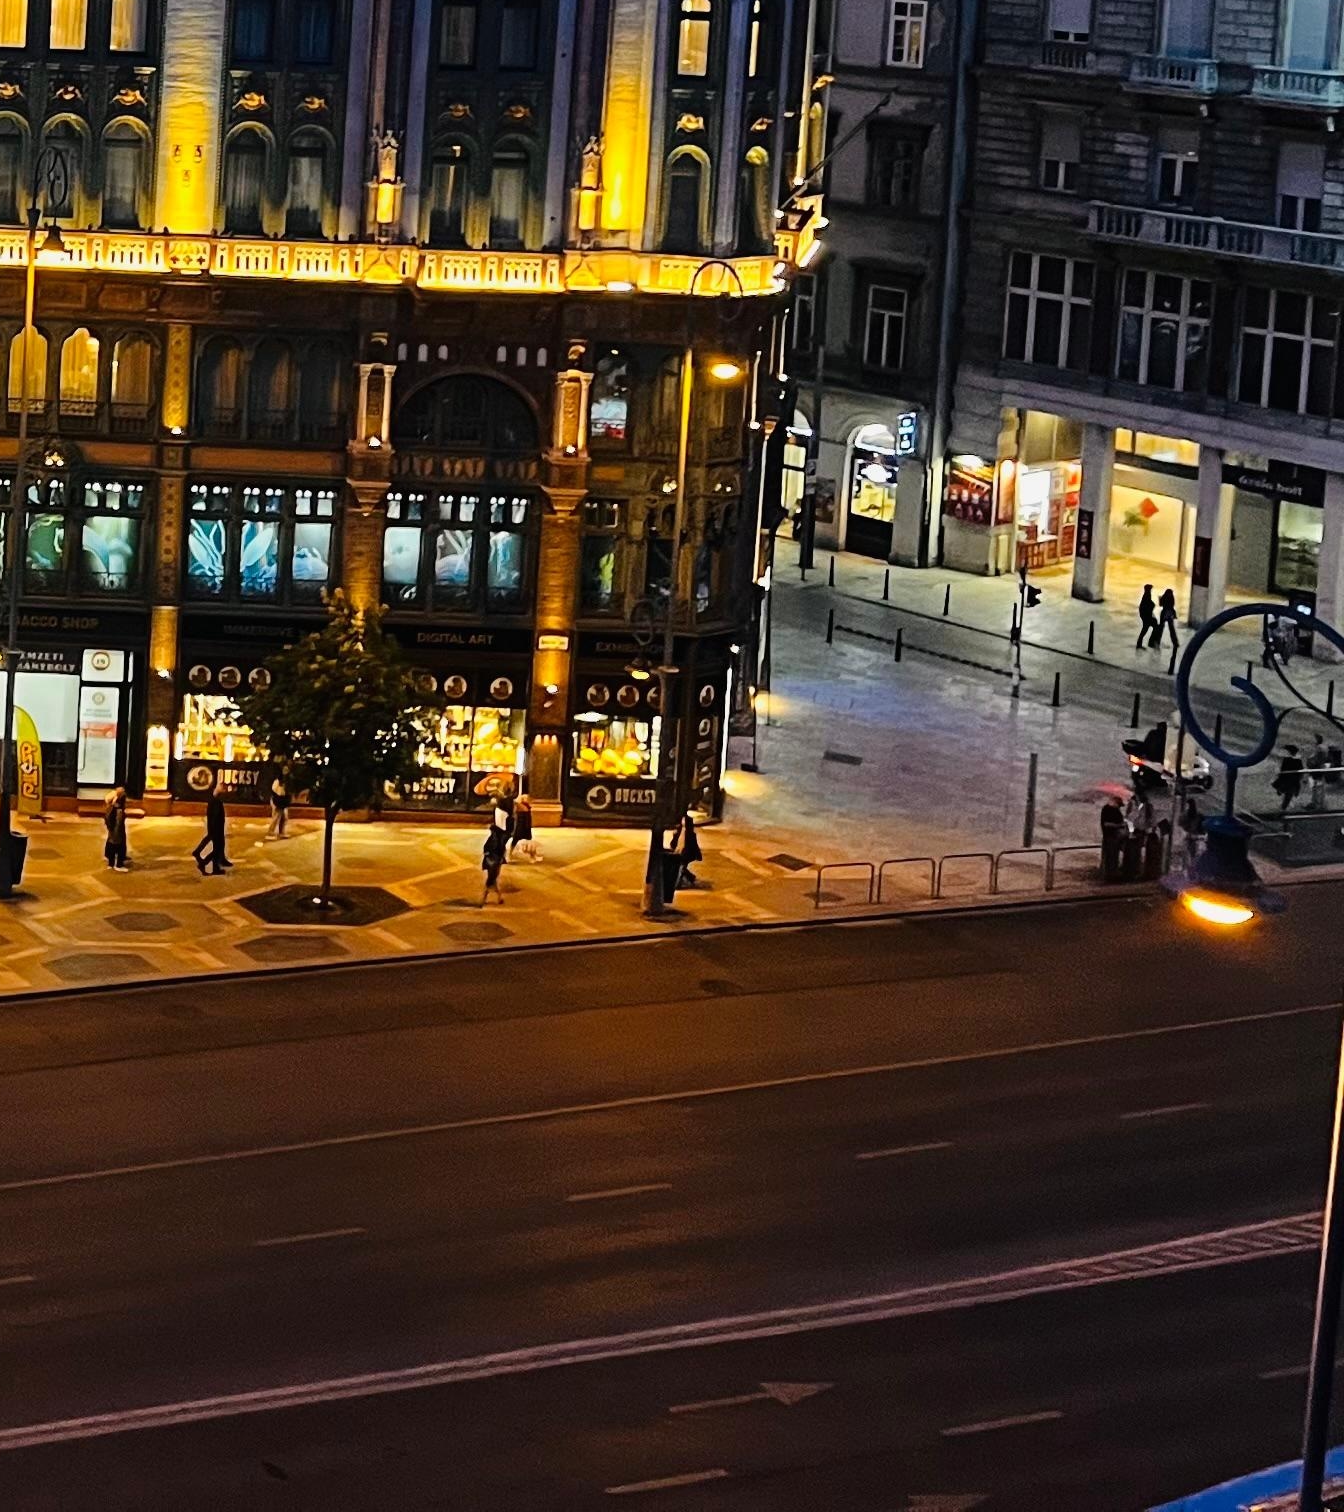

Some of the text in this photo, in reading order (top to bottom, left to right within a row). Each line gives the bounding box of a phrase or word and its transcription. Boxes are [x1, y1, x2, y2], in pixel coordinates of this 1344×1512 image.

[416, 632, 495, 646] DIGITAL ART
[216, 768, 260, 786] DUCKSY
